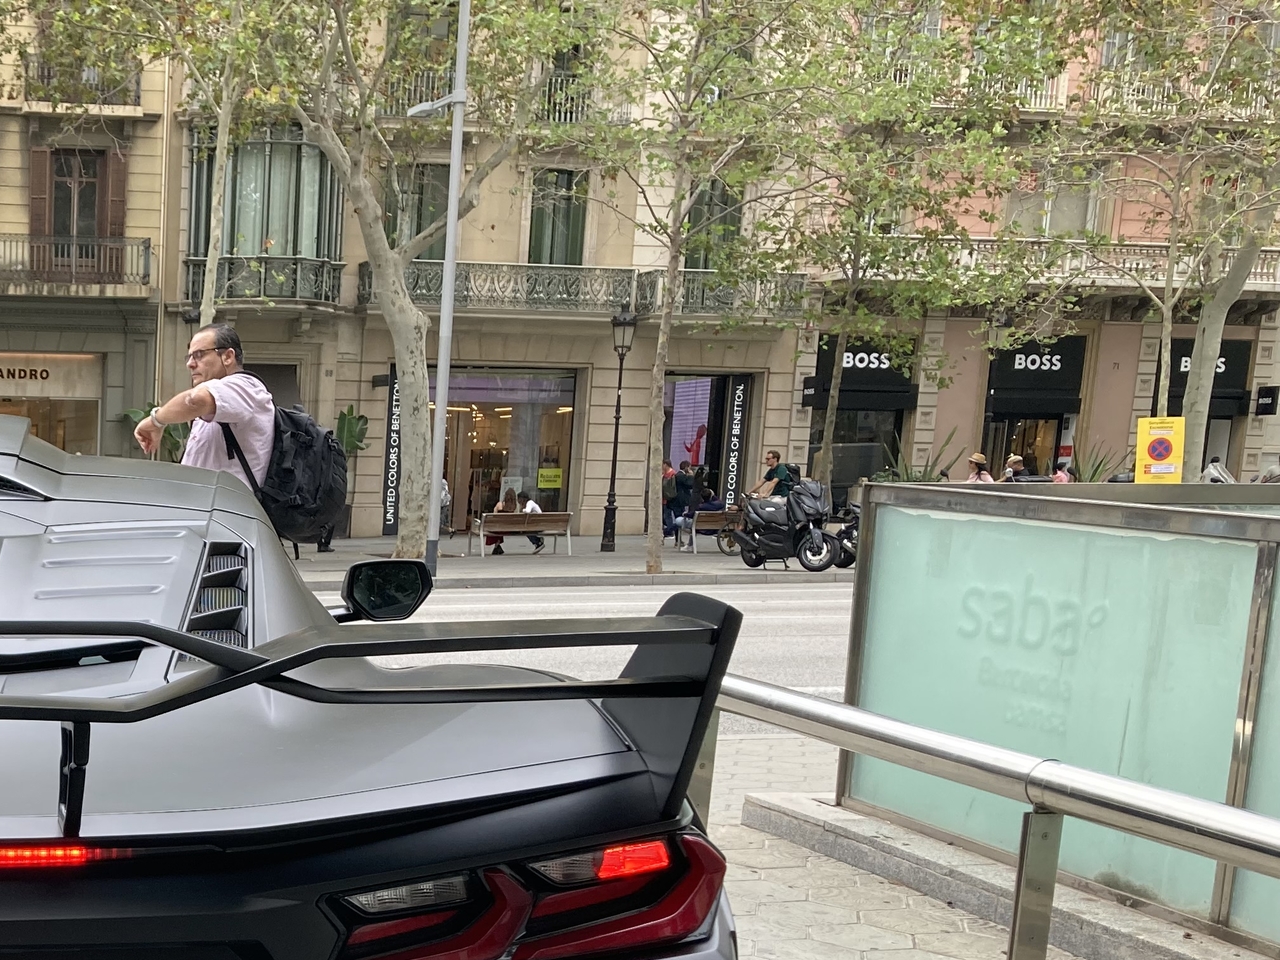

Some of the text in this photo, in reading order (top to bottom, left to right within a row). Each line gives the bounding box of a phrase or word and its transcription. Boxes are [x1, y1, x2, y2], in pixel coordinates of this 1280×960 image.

[842, 352, 890, 369] BOSS
[1014, 354, 1061, 370] BOSS
[1180, 357, 1226, 373] BS
[732, 384, 744, 435] BENETTON.
[386, 380, 400, 525] UNITED COLORS OF BENETTON
[731, 438, 739, 450] OF
[728, 452, 738, 489] COLORS
